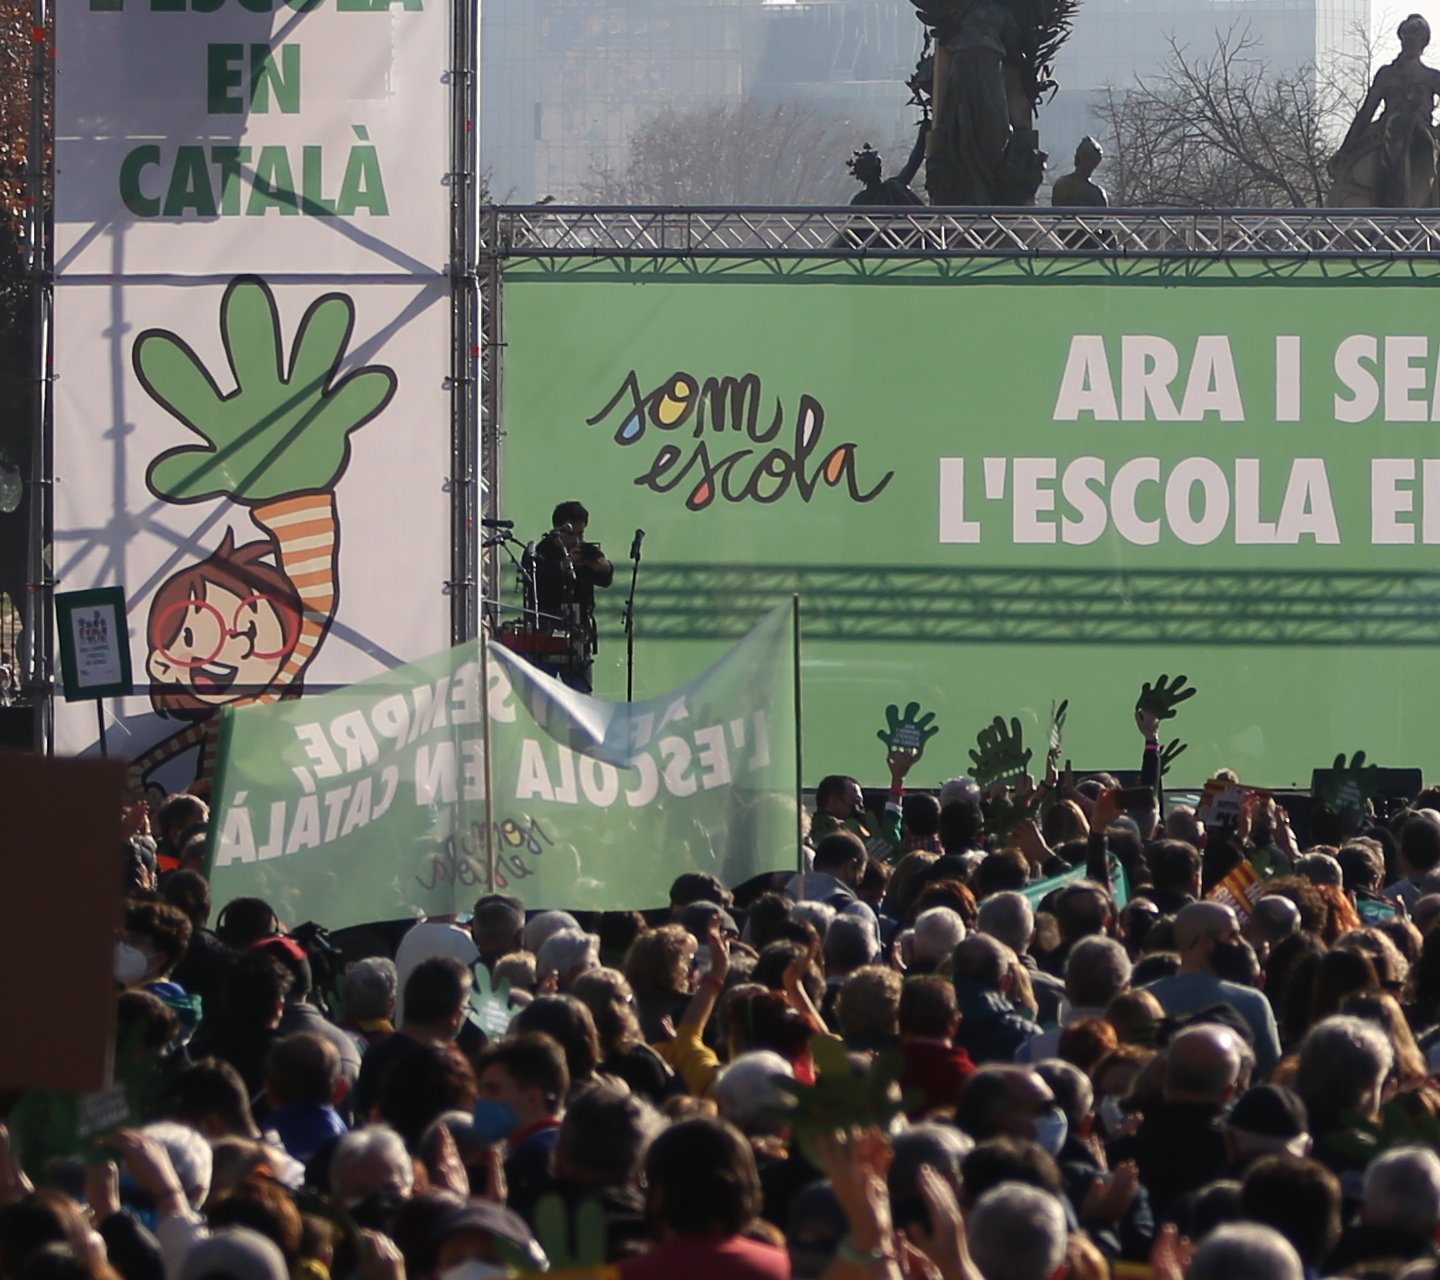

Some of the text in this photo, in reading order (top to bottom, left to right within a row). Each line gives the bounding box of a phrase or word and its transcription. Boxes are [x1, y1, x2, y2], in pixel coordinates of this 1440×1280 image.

[206, 42, 301, 116] EN
[118, 124, 390, 218] CATALÀ
[585, 370, 784, 446] som
[1053, 334, 1245, 421] ARA
[1275, 334, 1301, 421] I
[634, 394, 895, 512] escola
[939, 456, 1340, 545] L'ESCOLA
